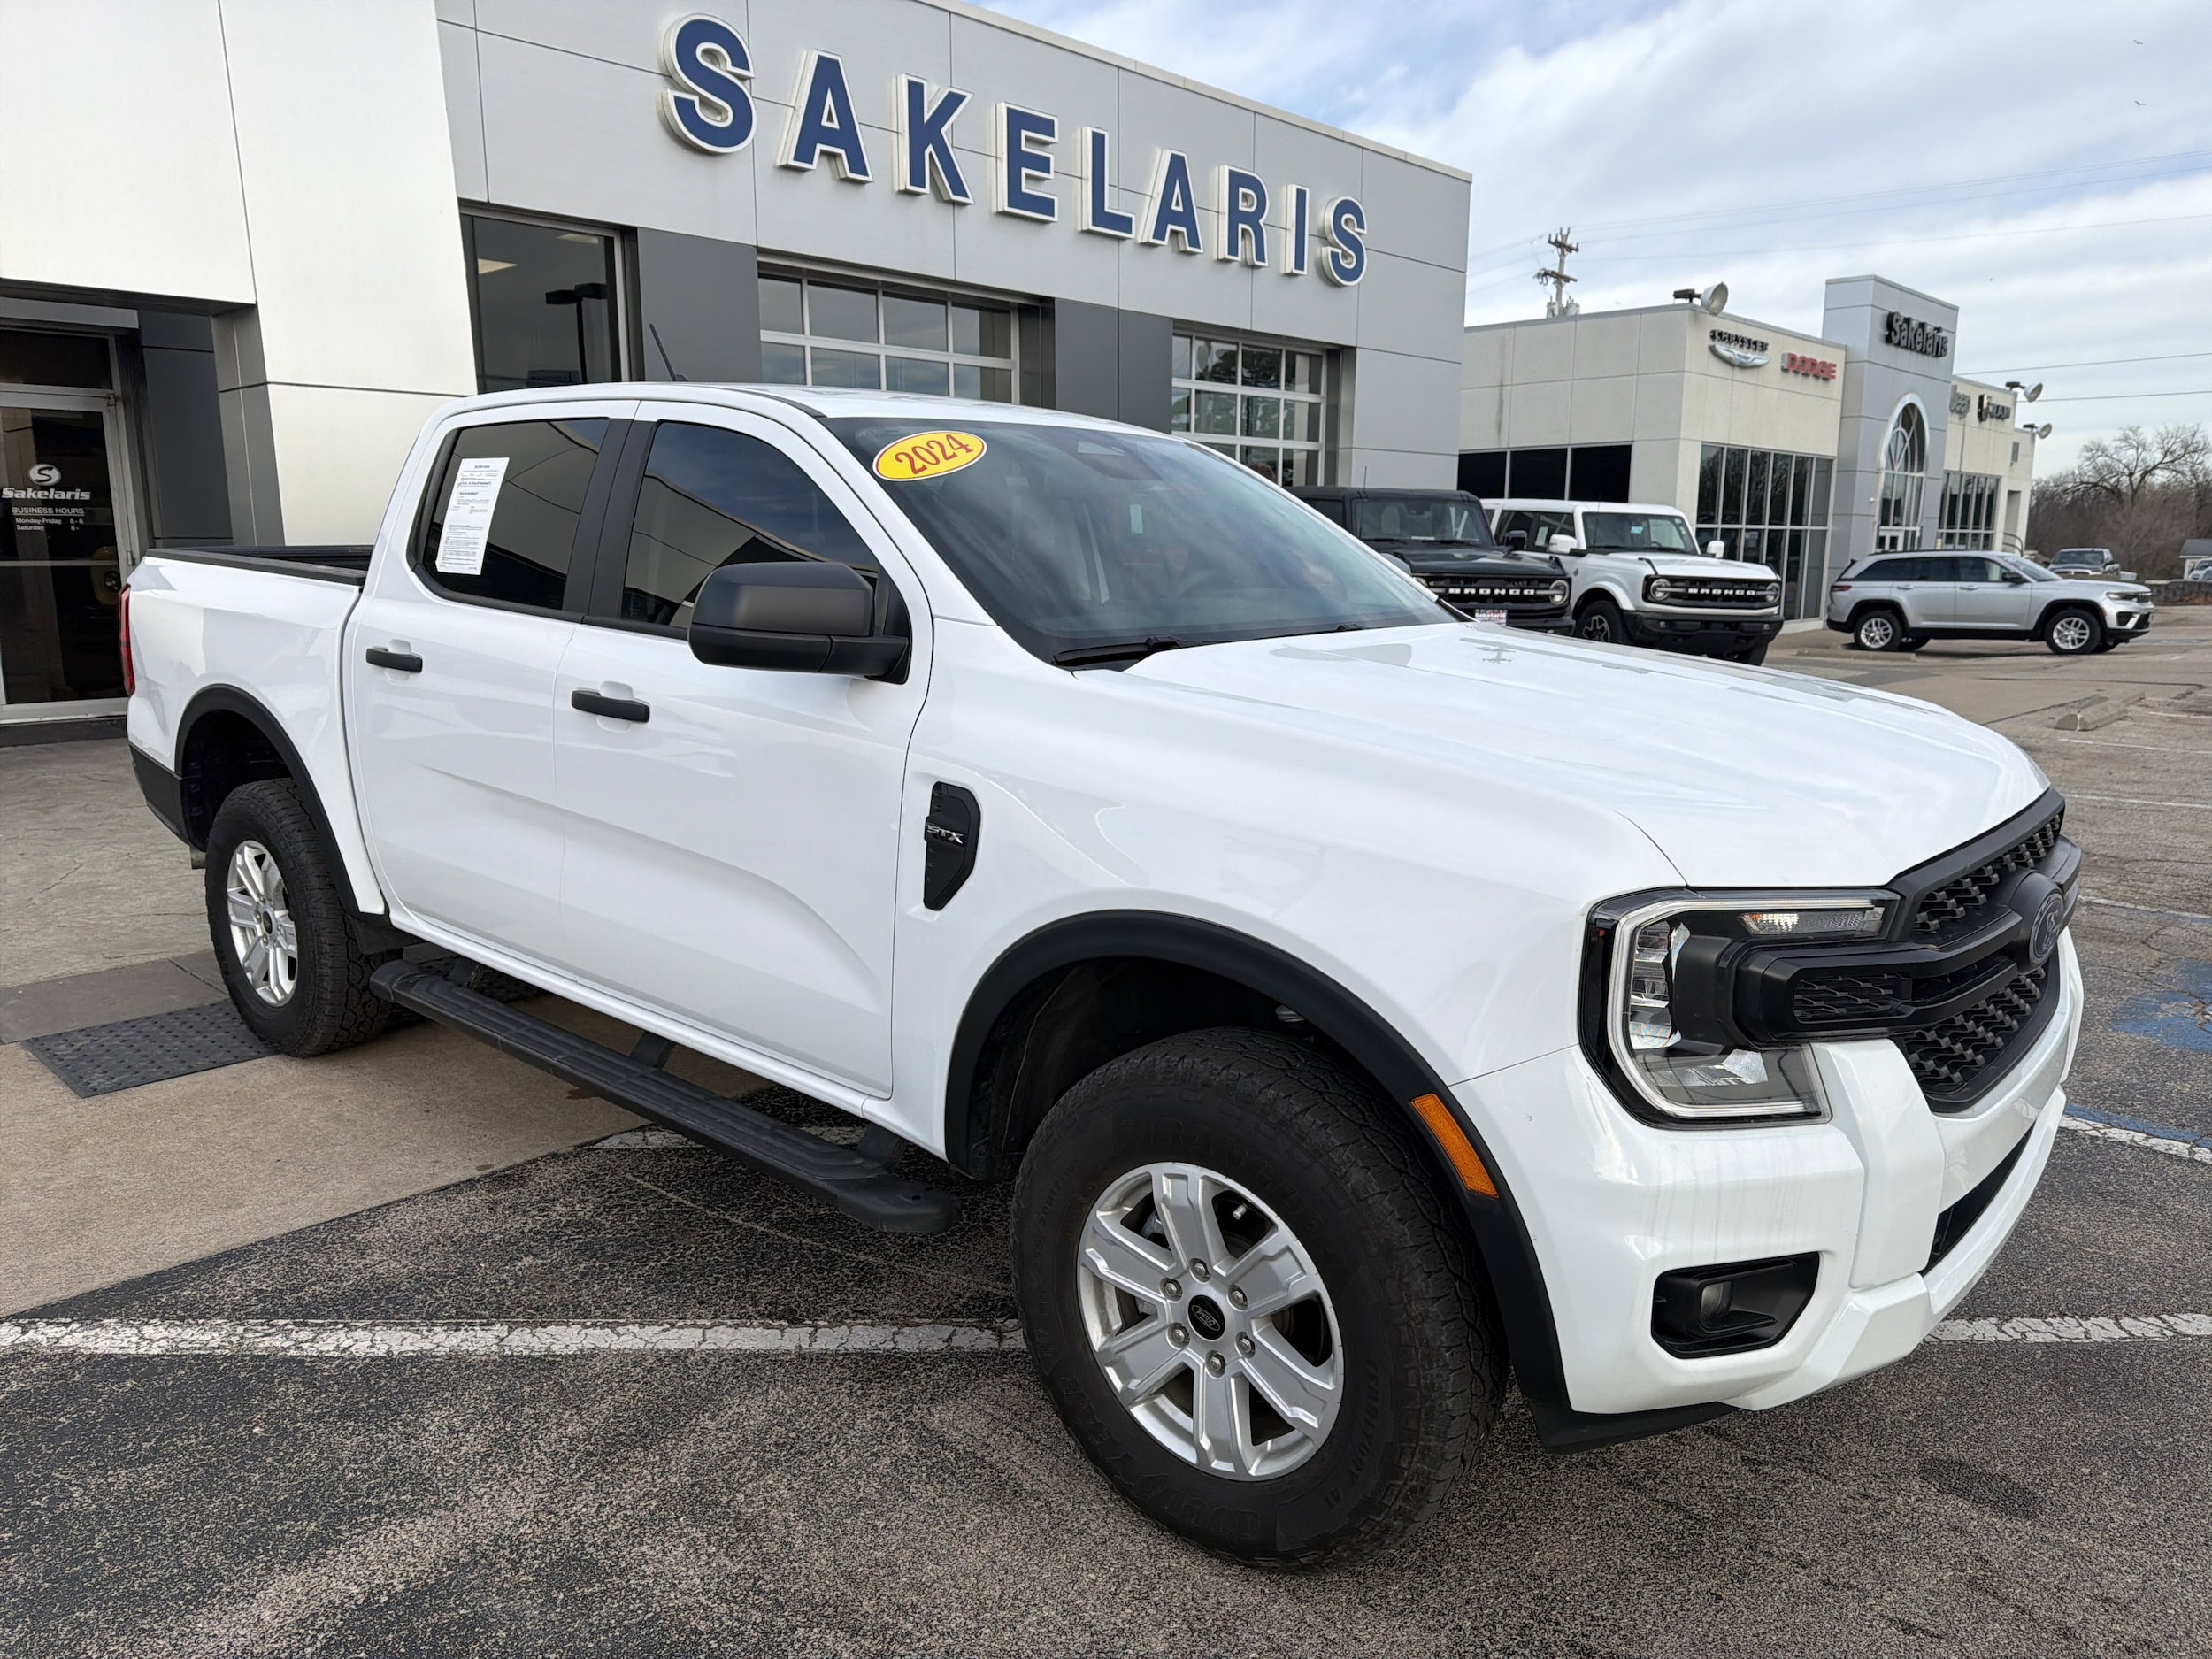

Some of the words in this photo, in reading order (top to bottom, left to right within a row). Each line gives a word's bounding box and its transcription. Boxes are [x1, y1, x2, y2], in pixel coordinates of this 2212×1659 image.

[658, 13, 1367, 287] SAKELARIS
[1886, 311, 1948, 358] Sakelaris
[1782, 352, 1838, 380] DODGE
[894, 434, 974, 475] 2024
[1, 487, 91, 501] Sakelaris
[12, 506, 54, 515] BUSINESS
[1448, 587, 1535, 595] BRONCO
[1687, 588, 1756, 596] BRONCO
[926, 824, 964, 844] STX
